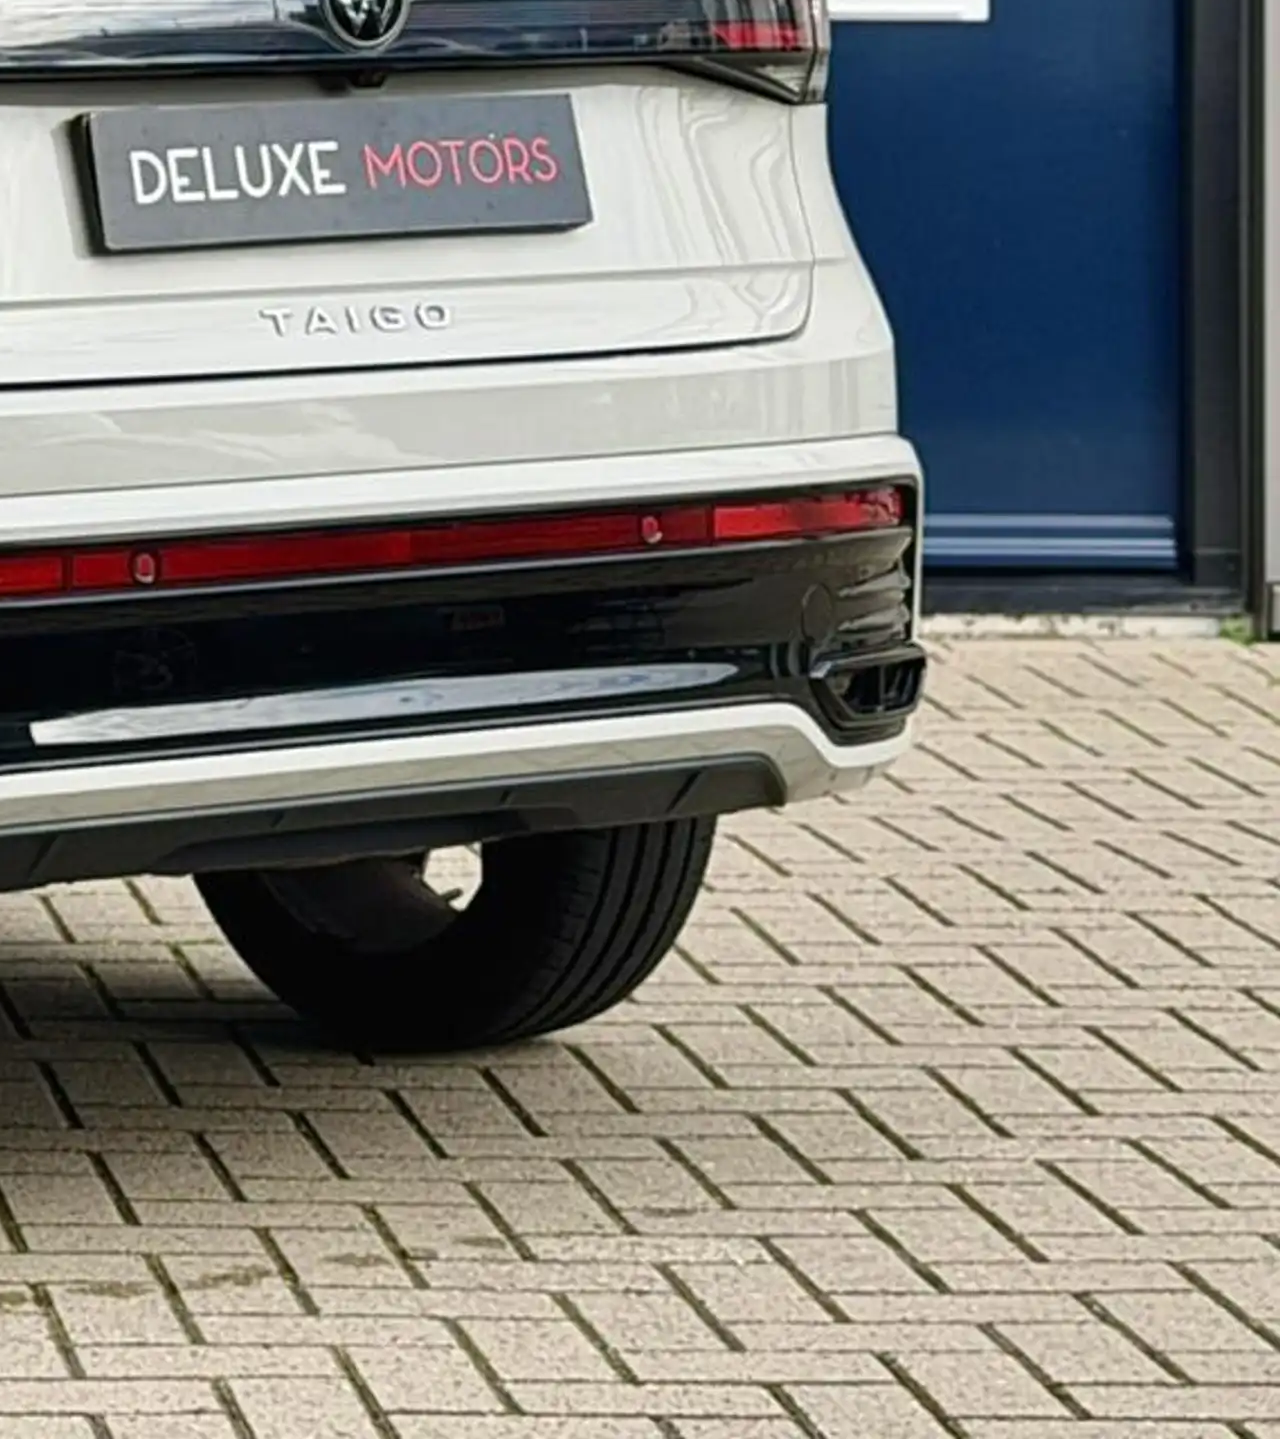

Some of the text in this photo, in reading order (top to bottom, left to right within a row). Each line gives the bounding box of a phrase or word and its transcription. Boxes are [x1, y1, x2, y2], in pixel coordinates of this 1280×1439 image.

[129, 137, 558, 205] DELUXE MOTORS
[260, 303, 450, 336] TAIGO
